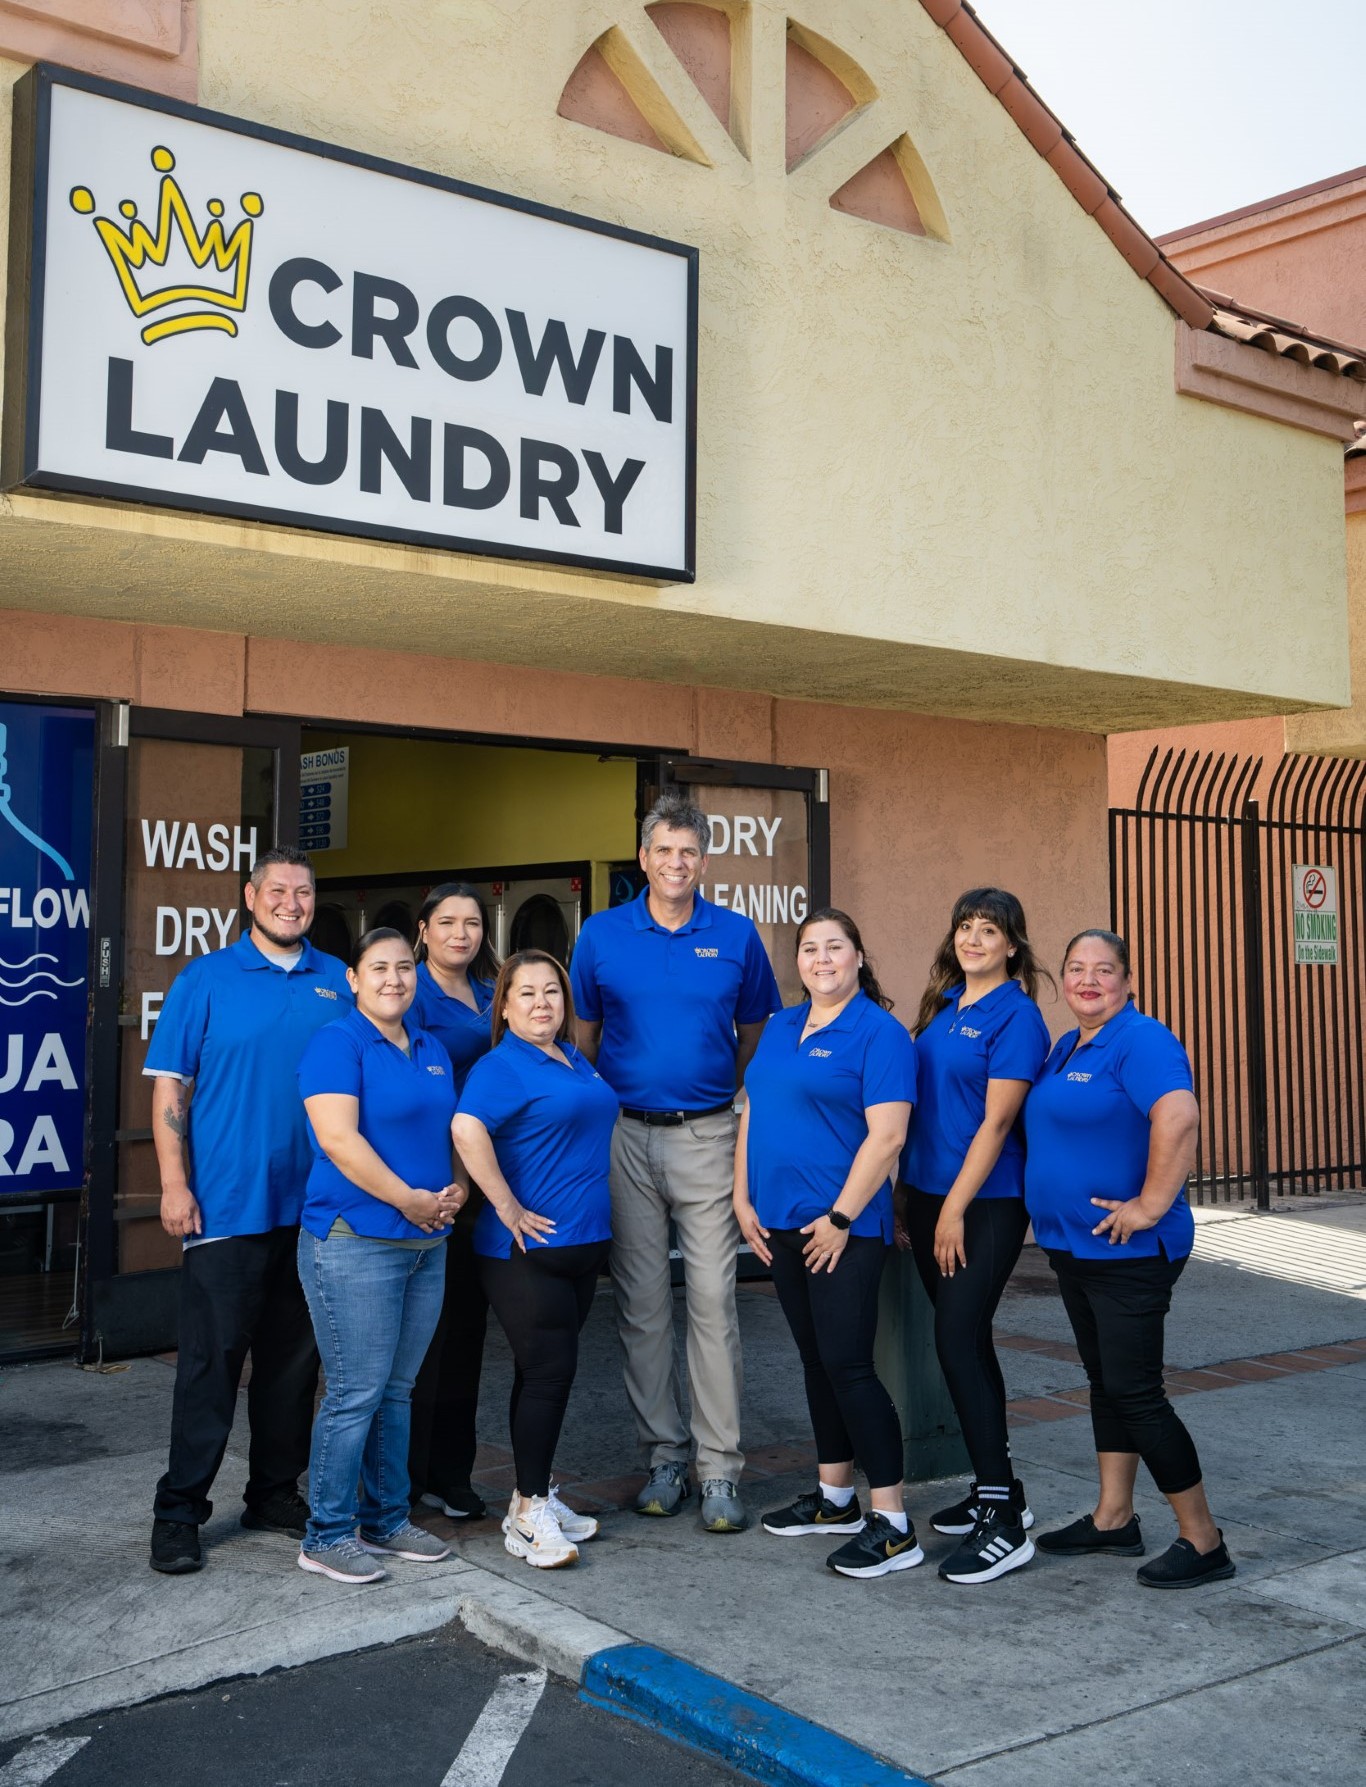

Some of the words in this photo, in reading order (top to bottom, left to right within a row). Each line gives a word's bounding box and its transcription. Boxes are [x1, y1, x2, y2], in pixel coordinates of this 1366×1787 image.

[268, 256, 674, 424] CROWN
[105, 356, 646, 535] LAUNDRY
[316, 750, 345, 768] BONUS
[141, 819, 258, 872] WASH
[706, 814, 783, 857] DRY
[155, 906, 238, 956] DRY
[1295, 912, 1305, 940] NO
[1306, 913, 1337, 941] SMOKING
[101, 941, 110, 976] PUSH
[1314, 944, 1336, 961] Sidewalk
